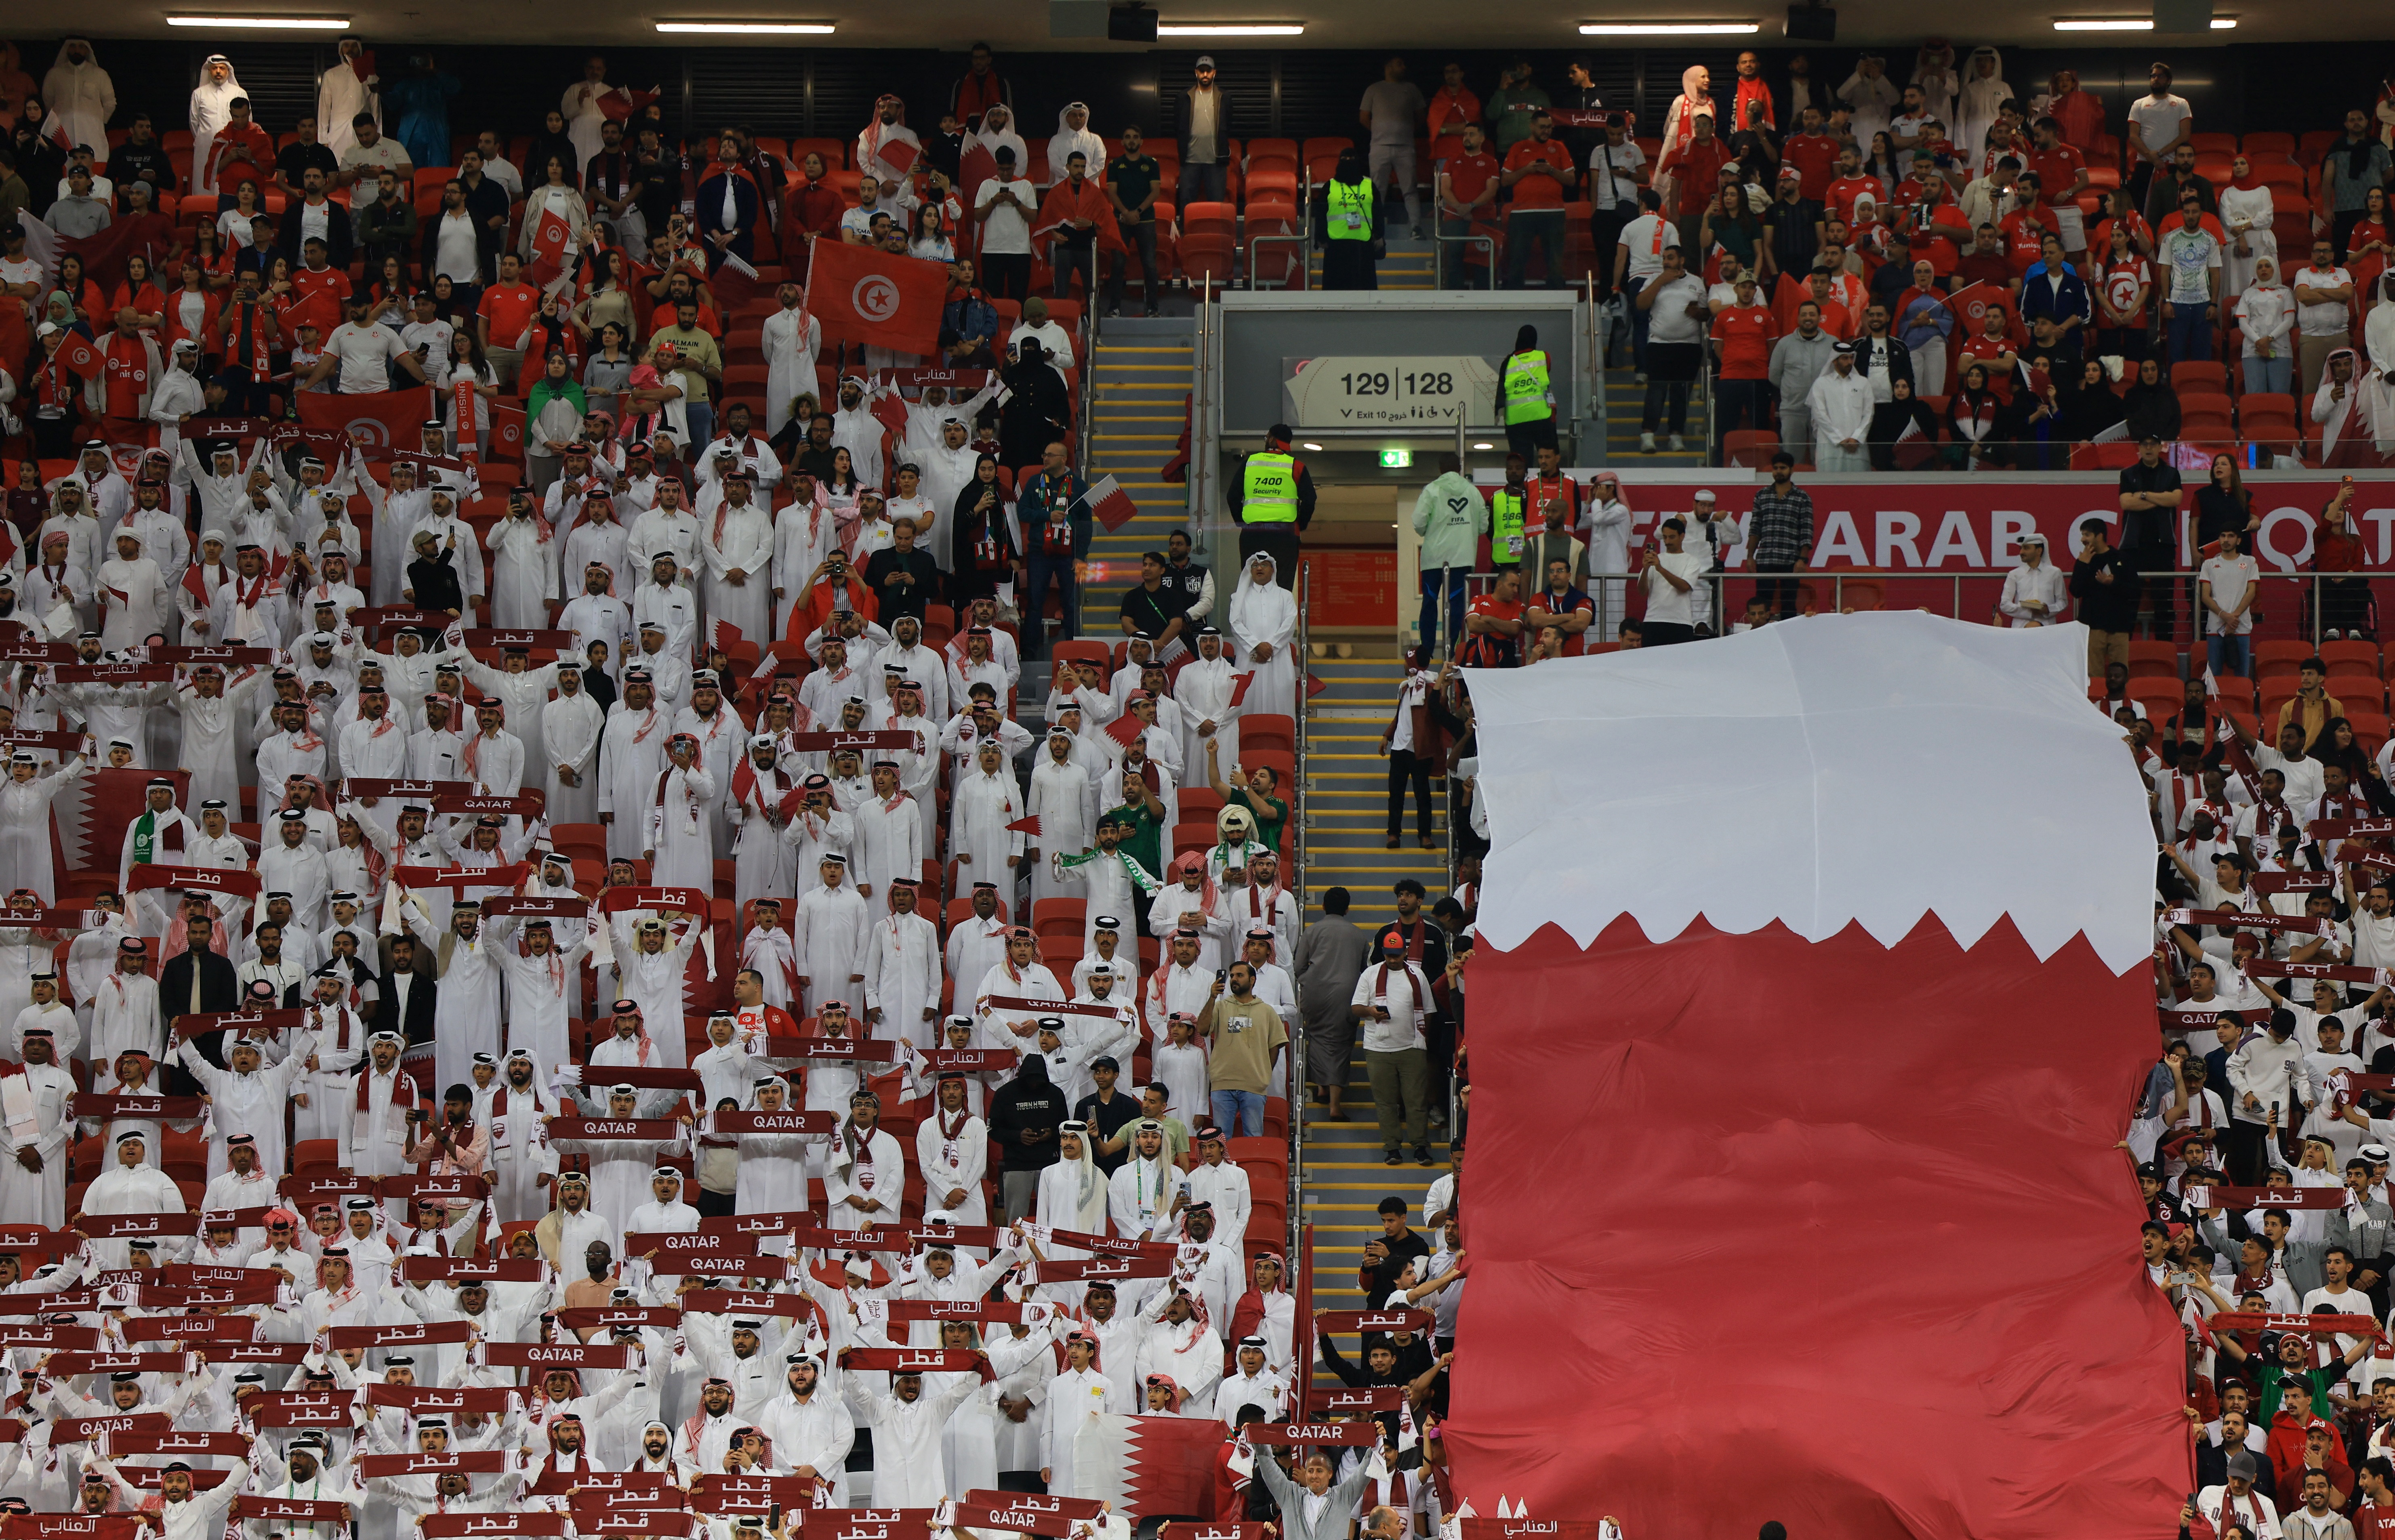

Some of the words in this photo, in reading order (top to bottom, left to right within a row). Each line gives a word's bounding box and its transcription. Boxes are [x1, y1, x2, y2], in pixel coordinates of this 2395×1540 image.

[1572, 112, 1607, 125] لعنابي
[914, 369, 955, 382] العنابي
[1341, 373, 1390, 395] 129
[1404, 373, 1453, 395] 128
[458, 381, 467, 416] UNISIA
[1389, 412, 1407, 422] خروج
[207, 421, 248, 435] قطر
[272, 426, 299, 441] قطر
[306, 431, 341, 443] أحب
[1255, 477, 1282, 485] 7400
[1502, 513, 1522, 521] 586
[1809, 511, 2037, 567] ARAB
[380, 612, 423, 624] قطر
[491, 632, 533, 645] قطر
[4, 646, 48, 659] قطر
[189, 647, 233, 659] قطر
[93, 666, 139, 677] العنابي
[0, 731, 43, 743] قطر
[833, 732, 875, 748] قطر
[388, 780, 433, 794] قطر
[2348, 819, 2392, 836] قطر
[2362, 853, 2395, 866] طر
[170, 869, 220, 885] قطر
[2284, 874, 2329, 890] قطر
[636, 888, 685, 907] قطر
[508, 900, 554, 912] قطر
[215, 1010, 262, 1027] قطر
[2182, 1013, 2215, 1024] QAT
[808, 1042, 853, 1055] قطر
[938, 1052, 983, 1065] العنابي
[2284, 1060, 2296, 1072] 90
[113, 1100, 161, 1114] قطر
[585, 1122, 636, 1134] QATAR
[754, 1116, 805, 1128] QATAR
[309, 1178, 357, 1192] قطر
[412, 1179, 460, 1195] قطر
[2253, 1190, 2302, 1206] قطر
[206, 1210, 235, 1222] قط
[109, 1218, 158, 1235] قطر
[737, 1216, 783, 1231] قطر
[0, 1232, 38, 1246] قط
[835, 1231, 883, 1247] العنابي
[910, 1226, 955, 1238] قطر
[666, 1236, 719, 1249] QATAR
[1091, 1239, 1141, 1250] العنابي
[447, 1259, 497, 1276] قطر
[691, 1258, 745, 1270] QATAR
[1081, 1259, 1129, 1277] قطر
[90, 1271, 143, 1285] QATAR
[193, 1269, 244, 1282] العنابي
[38, 1292, 90, 1310] قطر
[183, 1290, 233, 1304] قطر
[725, 1295, 774, 1309] قطر
[598, 1310, 648, 1324] قطر
[931, 1302, 981, 1319] العنابي
[1356, 1313, 1405, 1328] قطر
[2265, 1313, 2309, 1327] قطر
[0, 1327, 53, 1344] قطر
[163, 1319, 214, 1338] العنابي
[374, 1325, 425, 1344] قطر
[230, 1345, 282, 1359] قطر
[528, 1348, 584, 1361] QATAR
[898, 1350, 944, 1368] قطر
[90, 1354, 140, 1370] قطر
[412, 1393, 463, 1407] قطر
[1328, 1391, 1372, 1408] قطر
[288, 1406, 339, 1424] قطر
[80, 1418, 133, 1435] QATAR
[2309, 1419, 2326, 1428] قطر
[1287, 1426, 1342, 1439] QATAR
[156, 1433, 209, 1450] قطر
[407, 1454, 458, 1471] قطر
[607, 1487, 658, 1506] قطر
[719, 1494, 772, 1511] قطر
[261, 1503, 314, 1516] قطر
[1009, 1497, 1059, 1511] قطر
[464, 1515, 517, 1534] قطر
[596, 1513, 648, 1530] قطر
[990, 1510, 1035, 1527] QATAR
[40, 1518, 95, 1534] العنابي
[837, 1524, 887, 1540] قطر
[1195, 1525, 1240, 1540] قطر
[1505, 1521, 1557, 1535] العنابي
